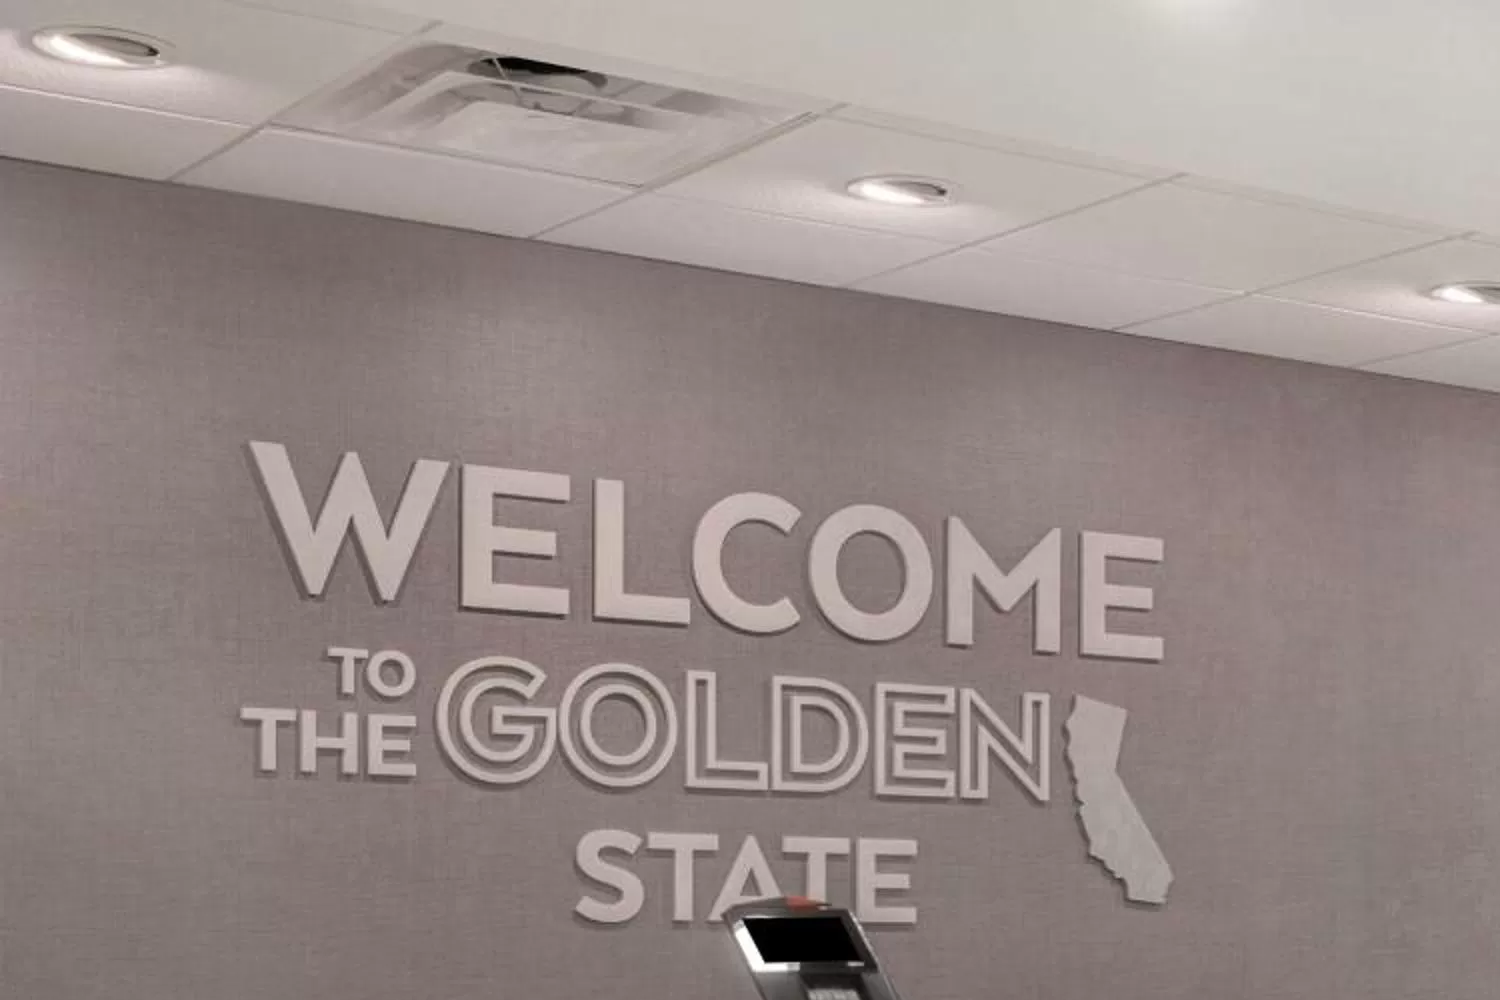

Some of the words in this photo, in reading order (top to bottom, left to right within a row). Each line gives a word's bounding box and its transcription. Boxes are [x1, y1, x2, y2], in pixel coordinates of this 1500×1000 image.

[248, 440, 1165, 662] WELCOME
[240, 706, 417, 778] THE
[434, 655, 1052, 803] GOLDEN
[327, 646, 417, 698] TO
[574, 827, 919, 926] STATE
